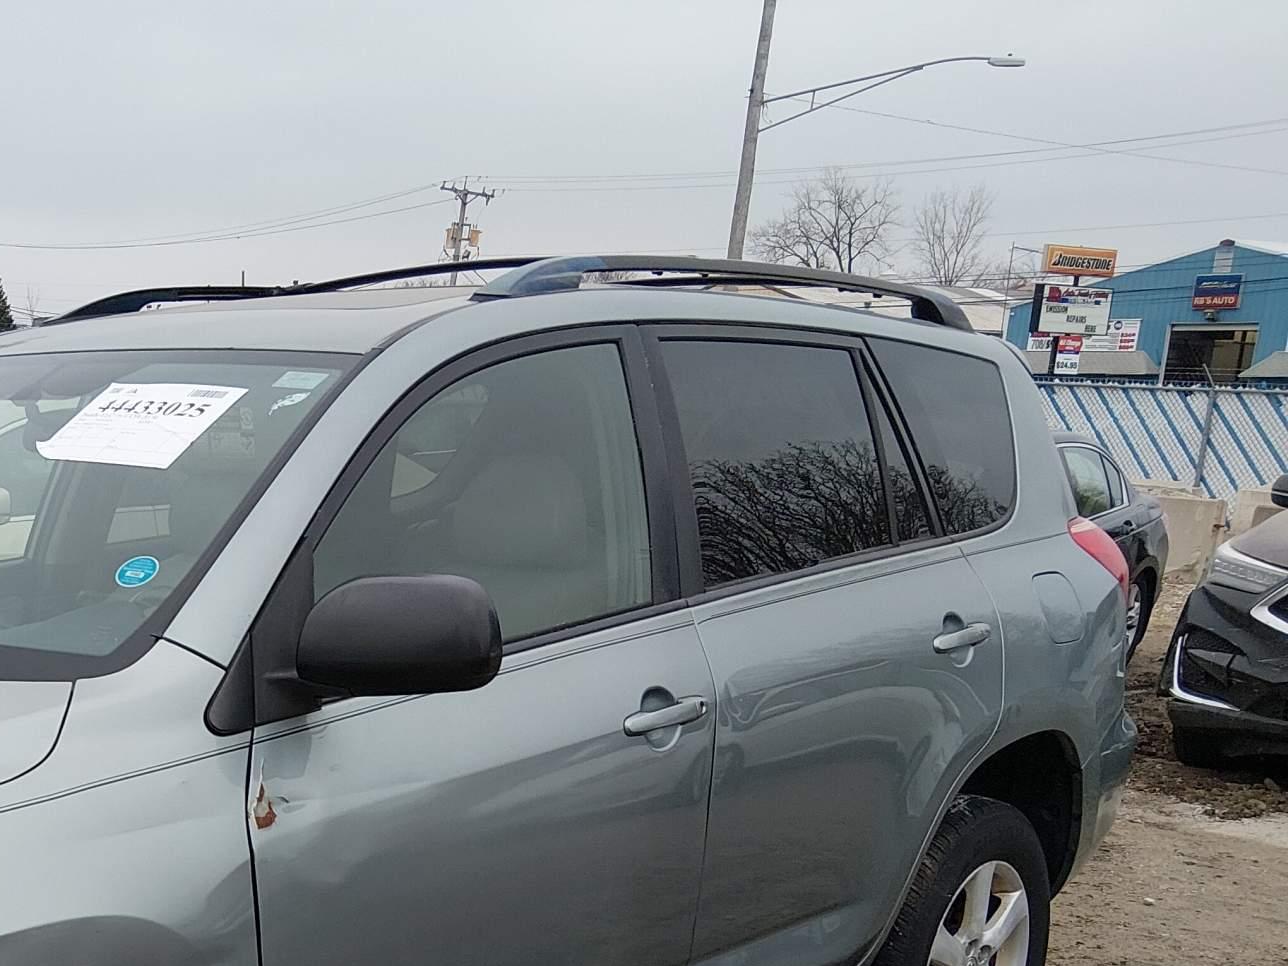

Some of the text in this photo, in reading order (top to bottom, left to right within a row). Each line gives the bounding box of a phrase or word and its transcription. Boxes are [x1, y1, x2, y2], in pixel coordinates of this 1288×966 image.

[1052, 253, 1112, 270] BRIDGESTONE
[1212, 296, 1235, 304] AUTO
[1066, 315, 1087, 323] REPAIRS
[97, 400, 212, 418] 44433025
